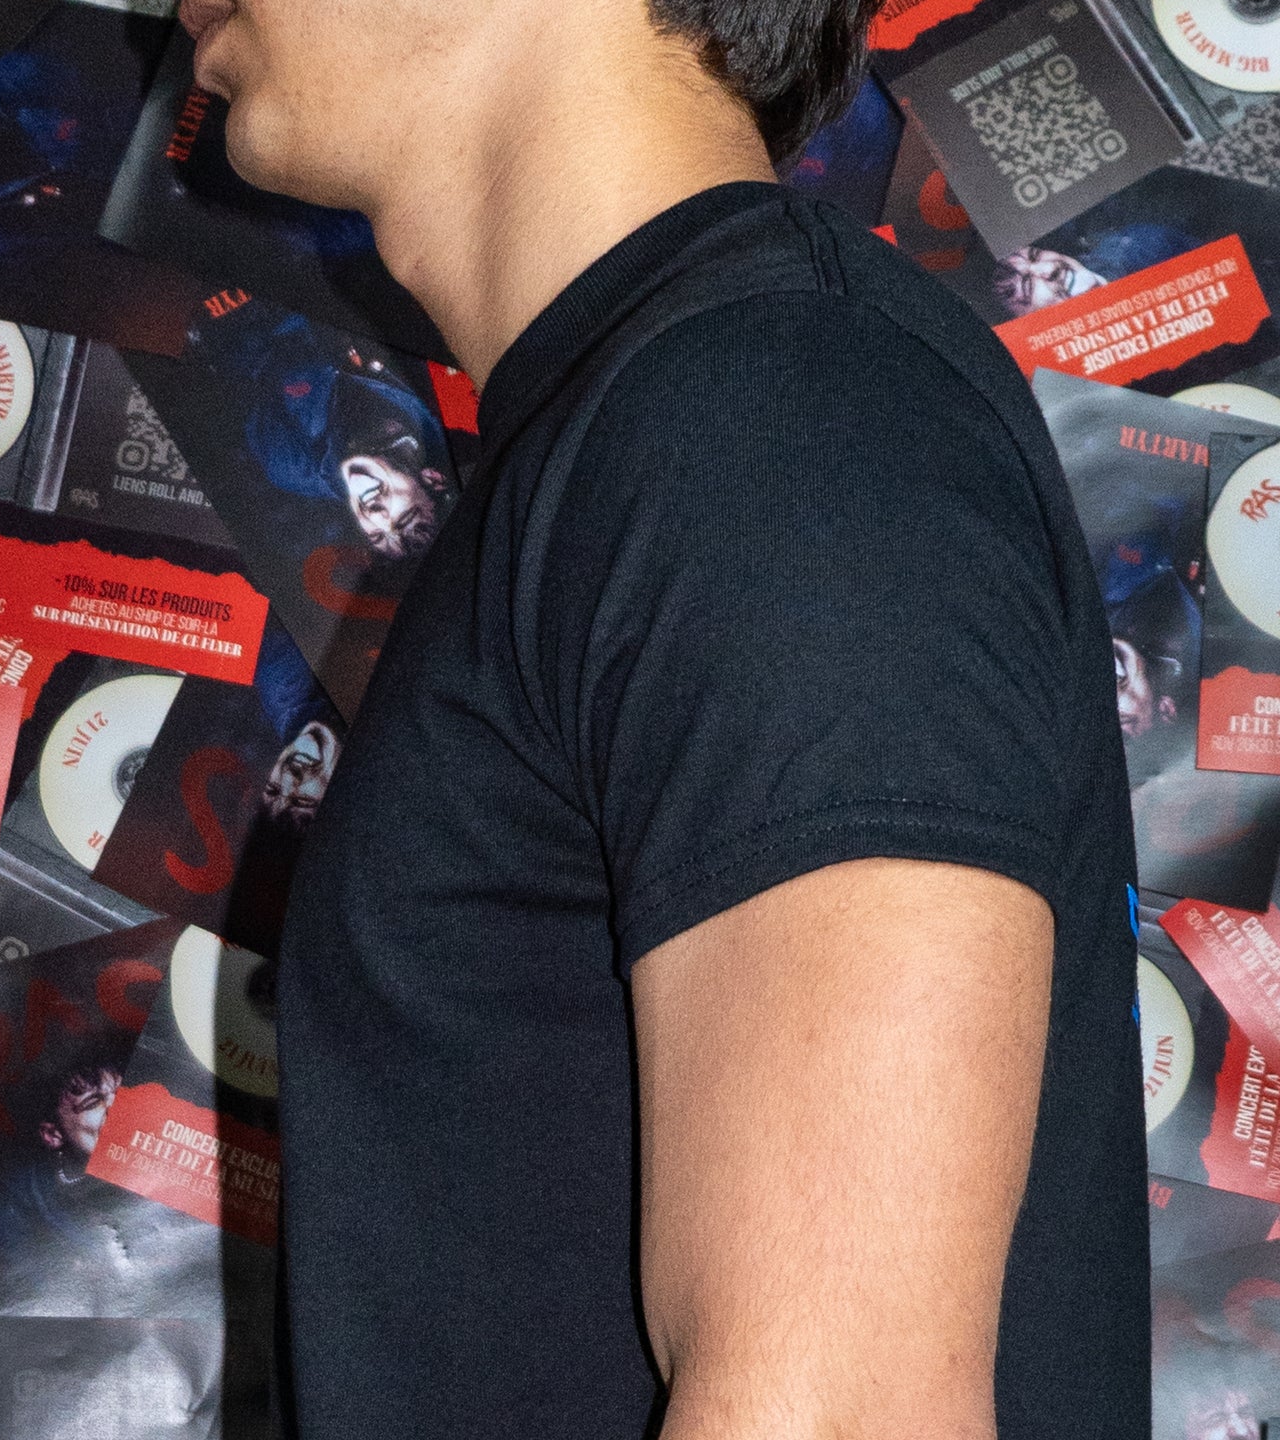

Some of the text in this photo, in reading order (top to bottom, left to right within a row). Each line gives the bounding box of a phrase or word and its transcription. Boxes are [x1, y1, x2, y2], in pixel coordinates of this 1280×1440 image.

[1051, 279, 1230, 366] FÊTE DE LA MUSIQUE
[1078, 305, 1216, 376] CONCERT EXCLUSIF
[97, 578, 131, 603] SUR
[130, 584, 159, 609] LES
[158, 590, 233, 624] PRODUITS
[32, 602, 243, 659] SUR PRÉSENTATION DE CE FLYER
[1228, 712, 1276, 735] FÊTE
